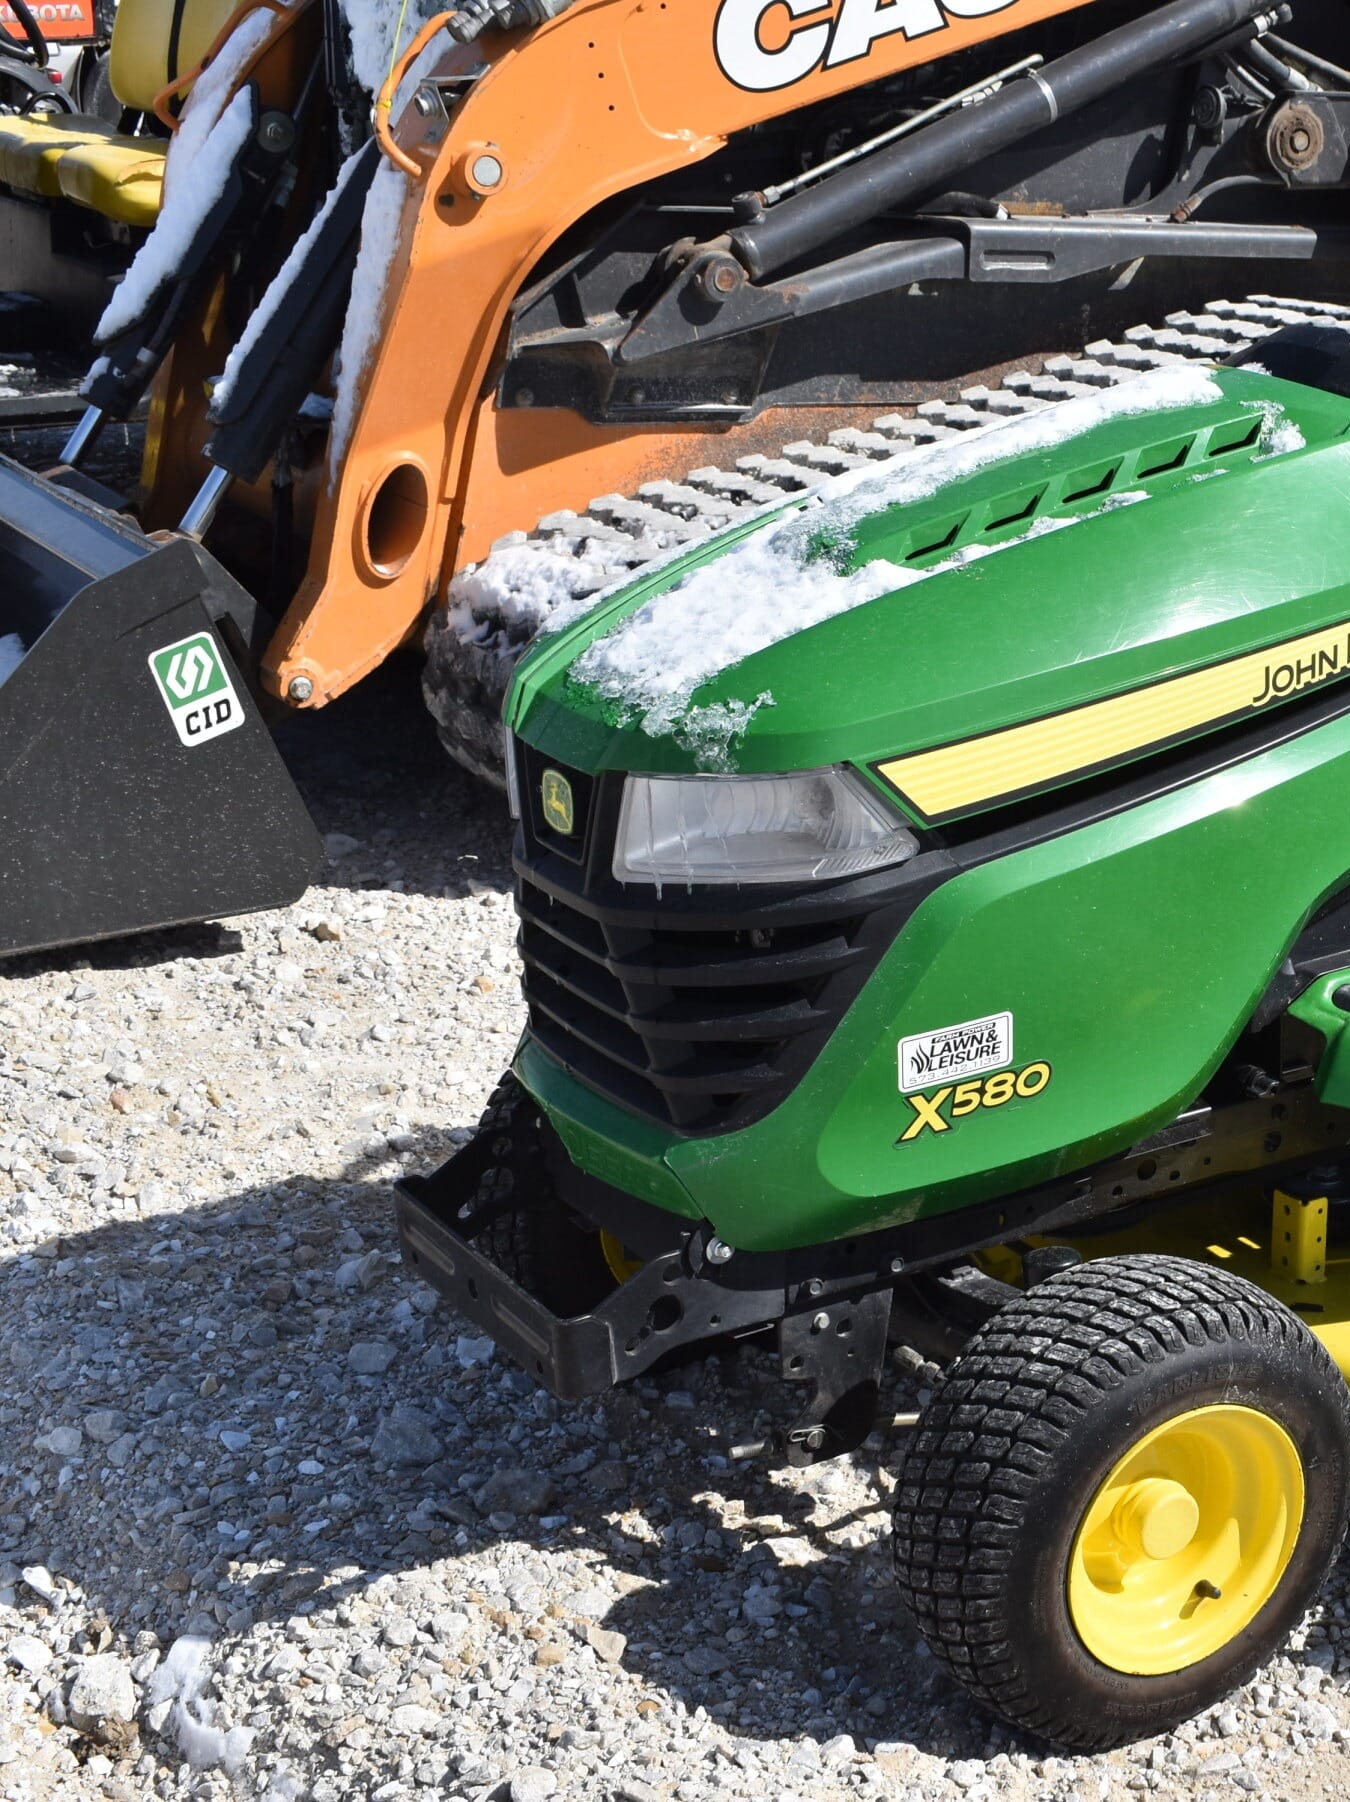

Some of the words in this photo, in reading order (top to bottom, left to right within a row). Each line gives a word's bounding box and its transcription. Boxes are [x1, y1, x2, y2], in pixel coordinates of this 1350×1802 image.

[712, 0, 1026, 92] CA
[1252, 643, 1339, 703] JOHN
[185, 698, 232, 736] CID
[927, 1041, 1002, 1072] LEISURE
[929, 1032, 984, 1058] LAWN
[985, 1029, 999, 1043] &
[908, 1055, 1001, 1085] 573.442.1139
[897, 1062, 1051, 1144] X580
